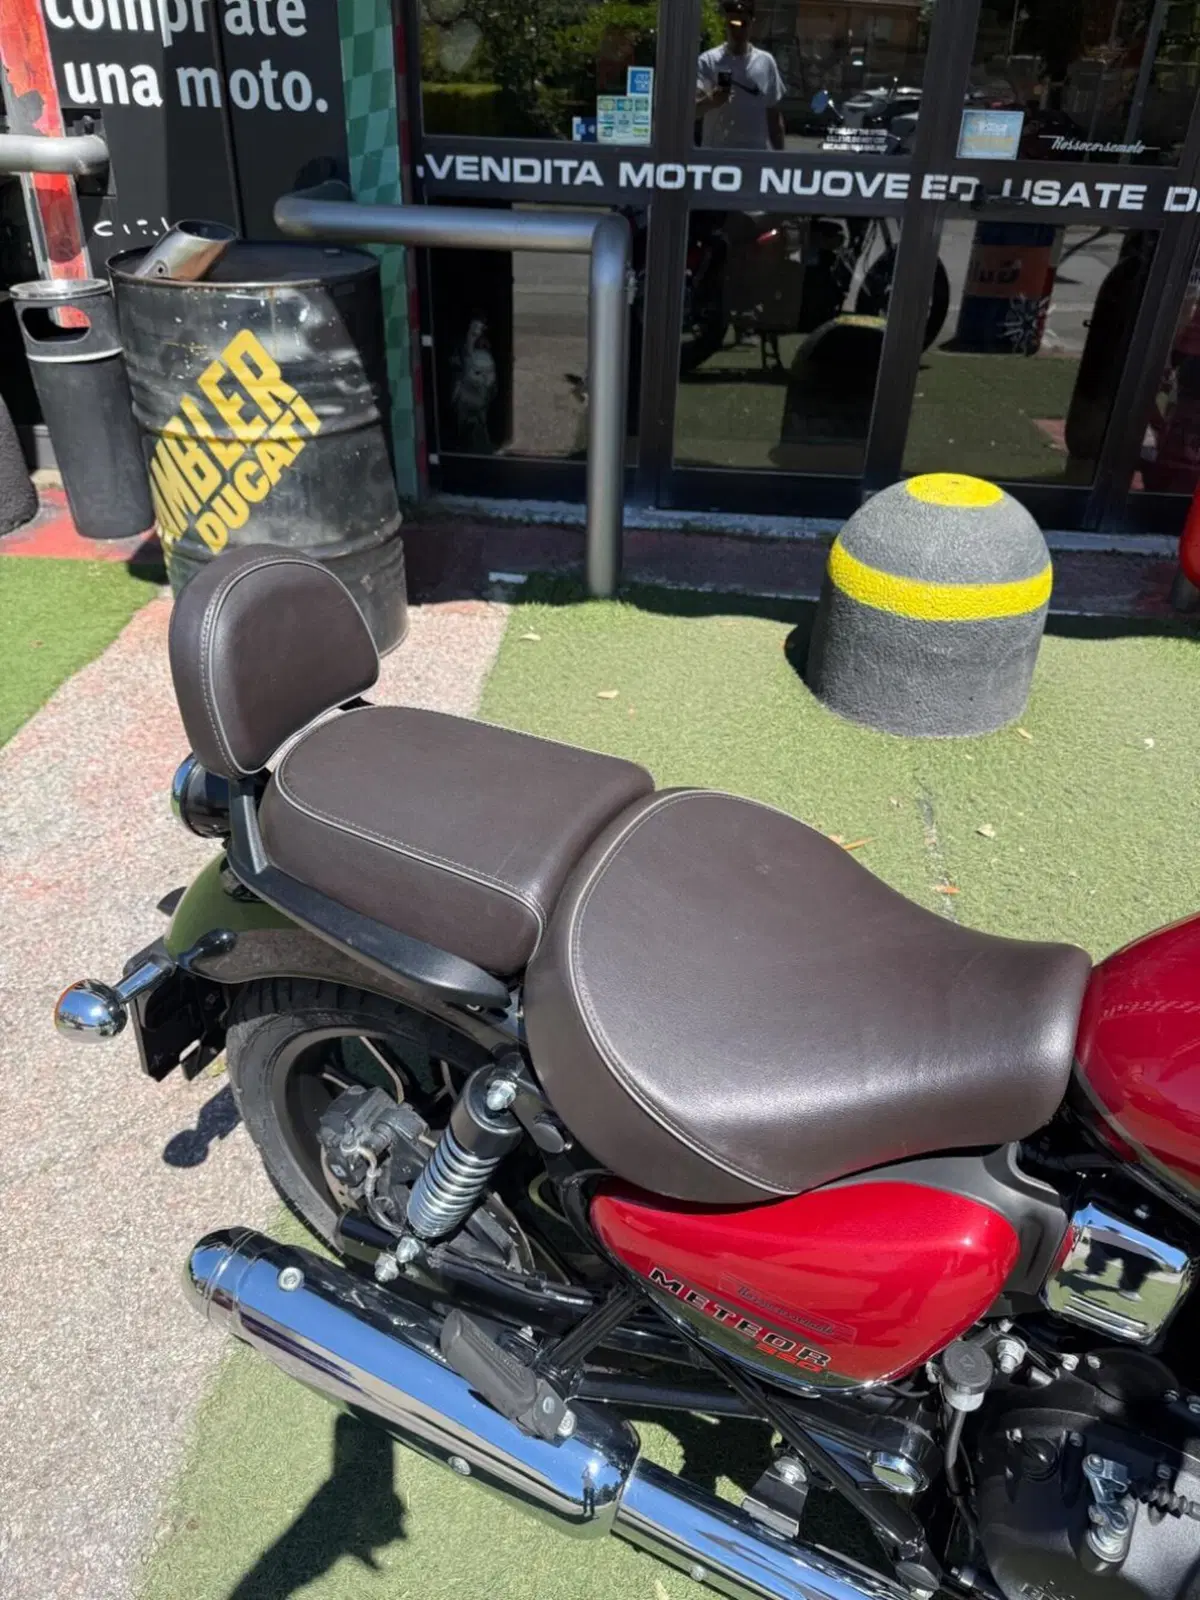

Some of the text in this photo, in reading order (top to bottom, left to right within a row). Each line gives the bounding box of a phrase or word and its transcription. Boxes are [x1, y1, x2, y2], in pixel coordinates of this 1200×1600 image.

[63, 59, 329, 113] una moto.
[424, 153, 603, 187] VENDITA
[619, 162, 742, 192] MOTO
[760, 168, 911, 199] NUOVE
[921, 174, 980, 201] ED
[1002, 178, 1148, 211] USATE
[195, 395, 321, 554] DUCATI
[649, 1267, 832, 1367] METEOR
